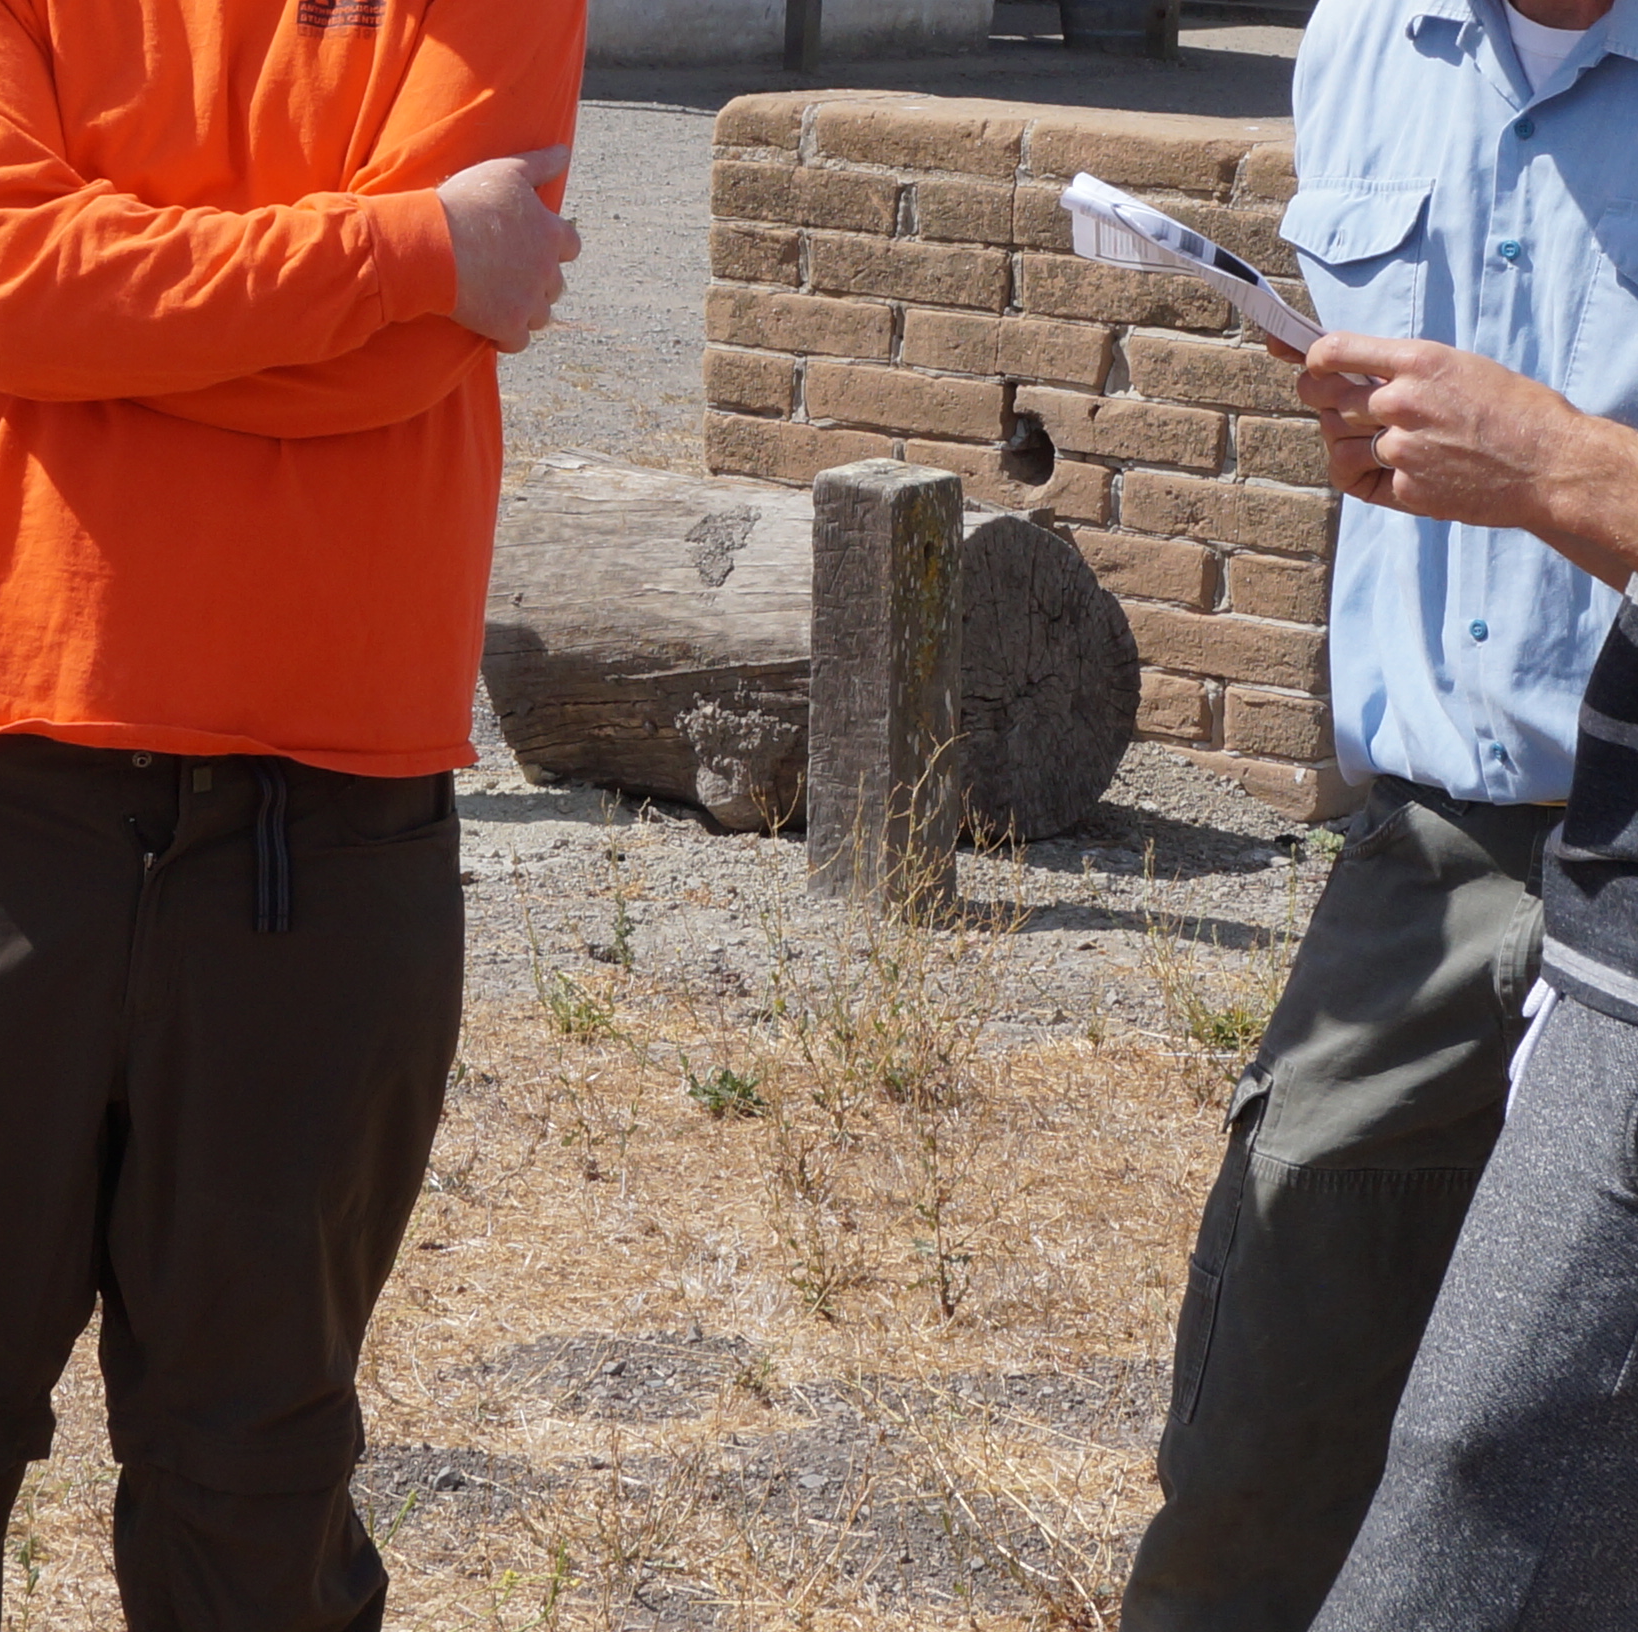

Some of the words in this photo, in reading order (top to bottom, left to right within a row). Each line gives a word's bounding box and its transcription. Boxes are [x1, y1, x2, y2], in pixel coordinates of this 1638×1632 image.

[300, 2, 385, 17] ANTHROPOLOGICA
[300, 13, 345, 26] STUDIES
[347, 14, 383, 25] CENTE
